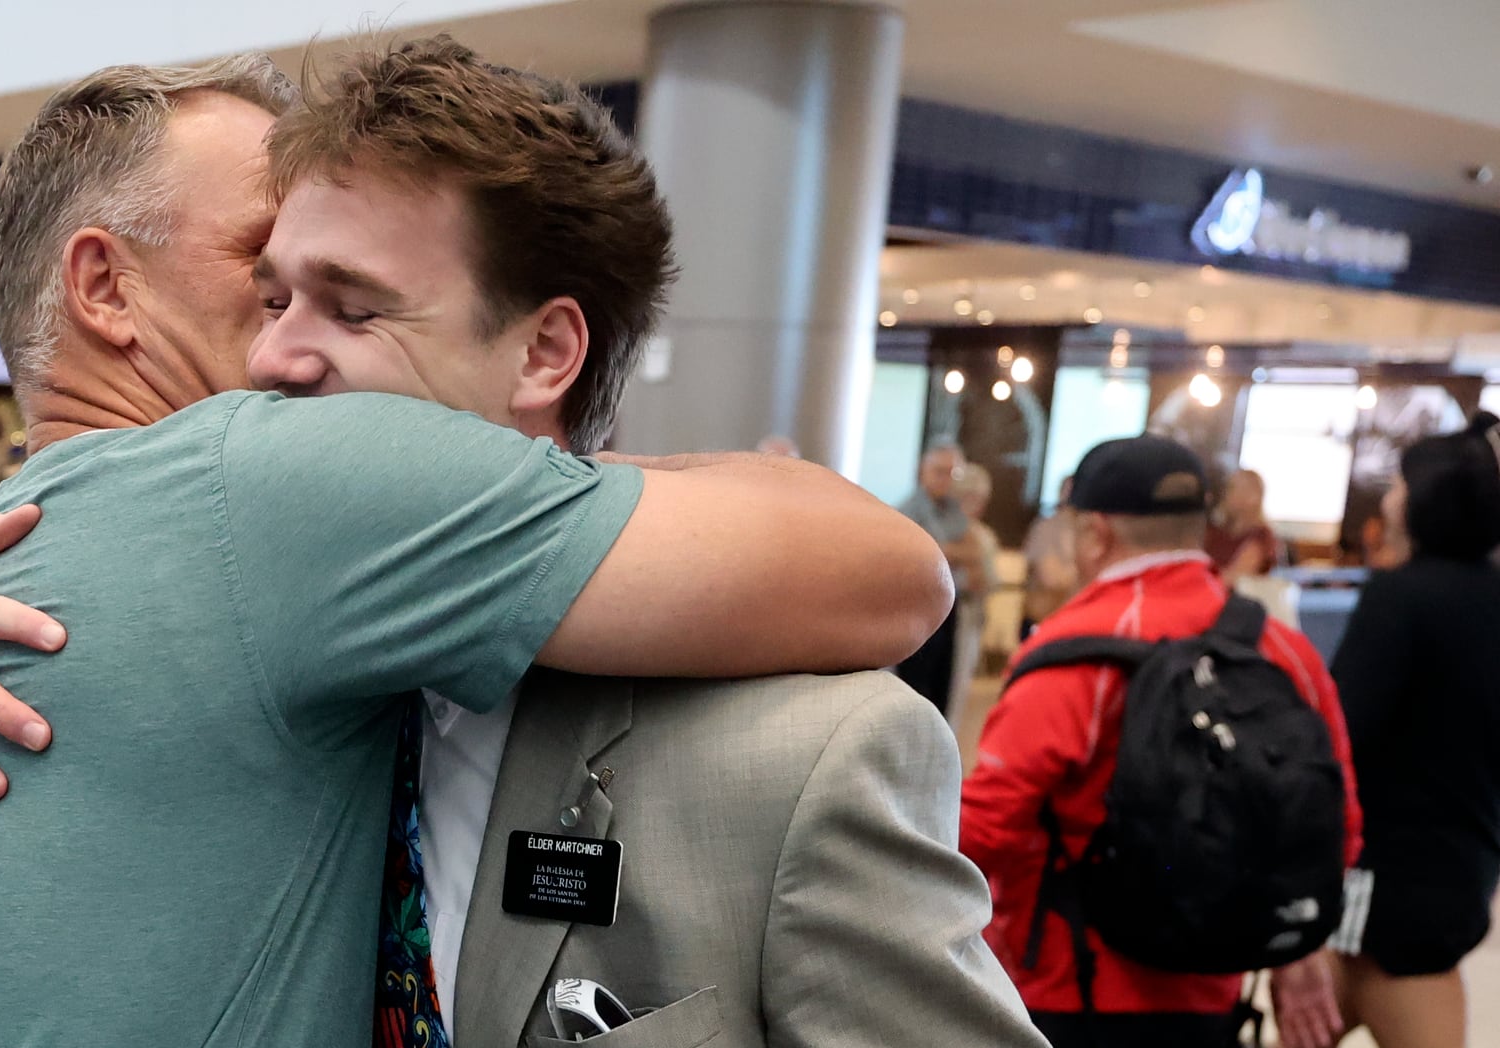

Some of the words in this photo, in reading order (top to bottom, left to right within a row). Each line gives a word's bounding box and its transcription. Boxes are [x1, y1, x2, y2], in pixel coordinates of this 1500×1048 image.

[527, 833, 554, 851] ÉLDER
[555, 840, 604, 857] KARTCHNER
[536, 864, 546, 873] LA
[532, 873, 587, 891] JESUCRISTO
